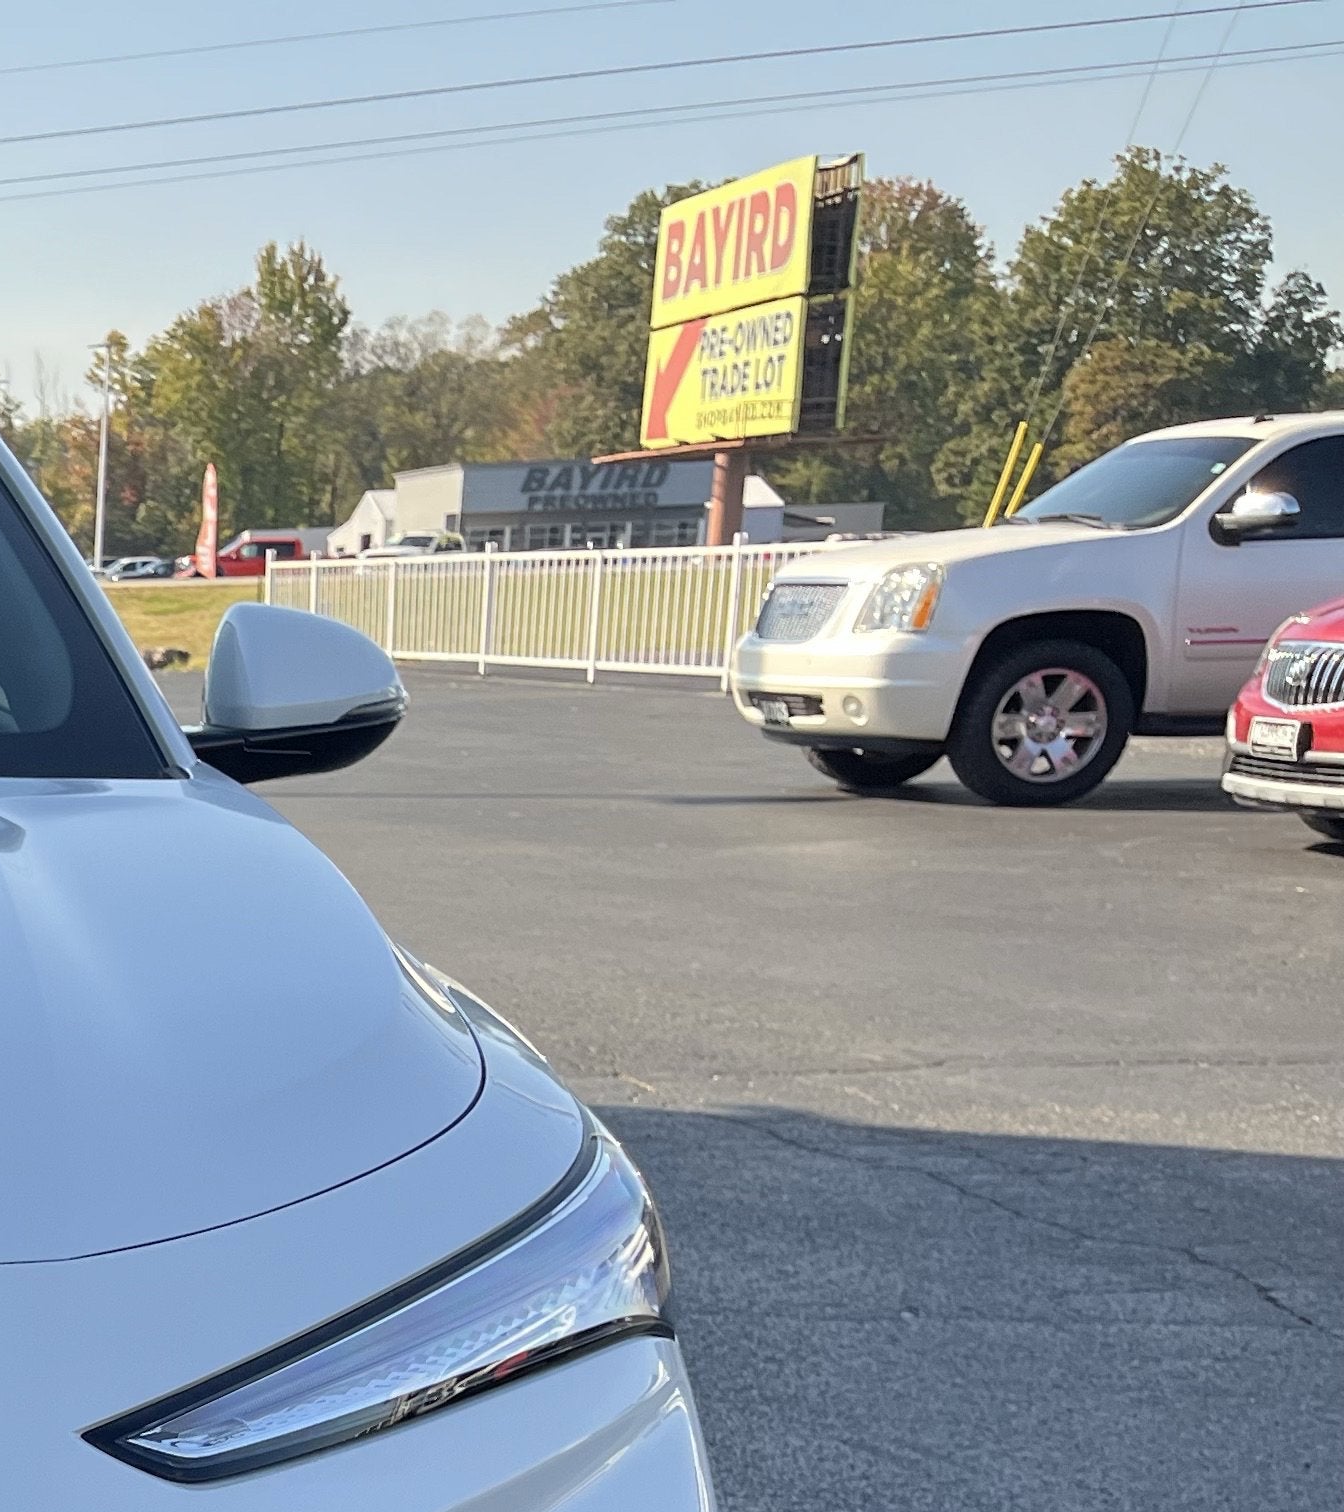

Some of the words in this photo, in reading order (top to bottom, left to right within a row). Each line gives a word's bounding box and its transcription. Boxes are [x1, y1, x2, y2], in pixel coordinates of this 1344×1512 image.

[662, 182, 797, 301] BAYIRD
[699, 311, 793, 362] PRE-OWNED
[701, 360, 750, 402] TRADE
[755, 353, 785, 394] LOT
[521, 462, 670, 493] BAYIRD
